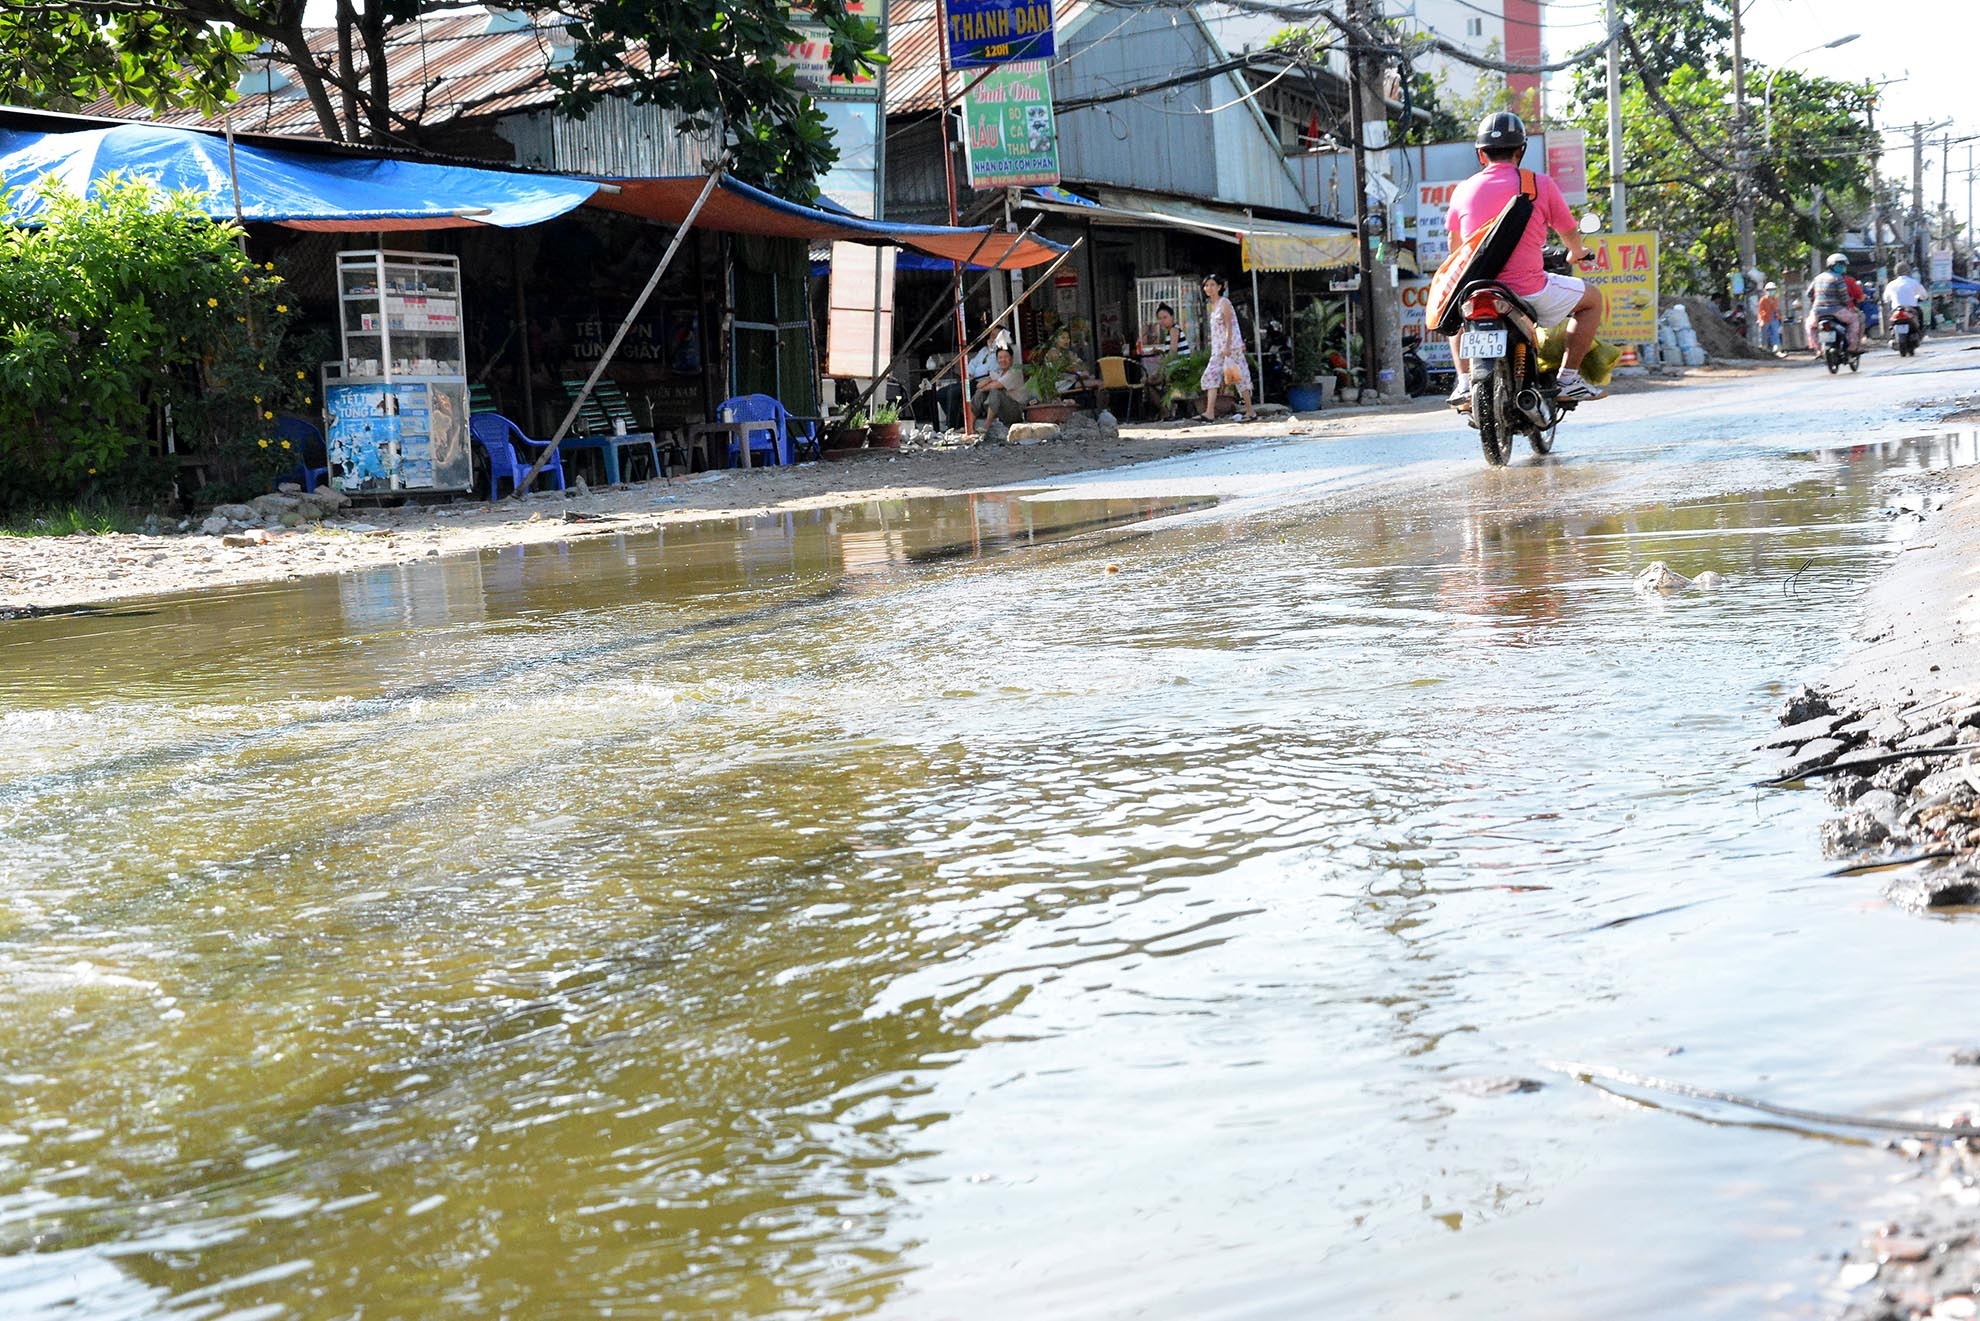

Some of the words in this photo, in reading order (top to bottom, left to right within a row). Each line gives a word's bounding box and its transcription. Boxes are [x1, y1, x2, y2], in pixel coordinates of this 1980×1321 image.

[950, 9, 1009, 42] THANH
[1617, 244, 1650, 270] TA
[1469, 332, 1498, 345] 84-C1
[1463, 344, 1503, 356] 114.19
